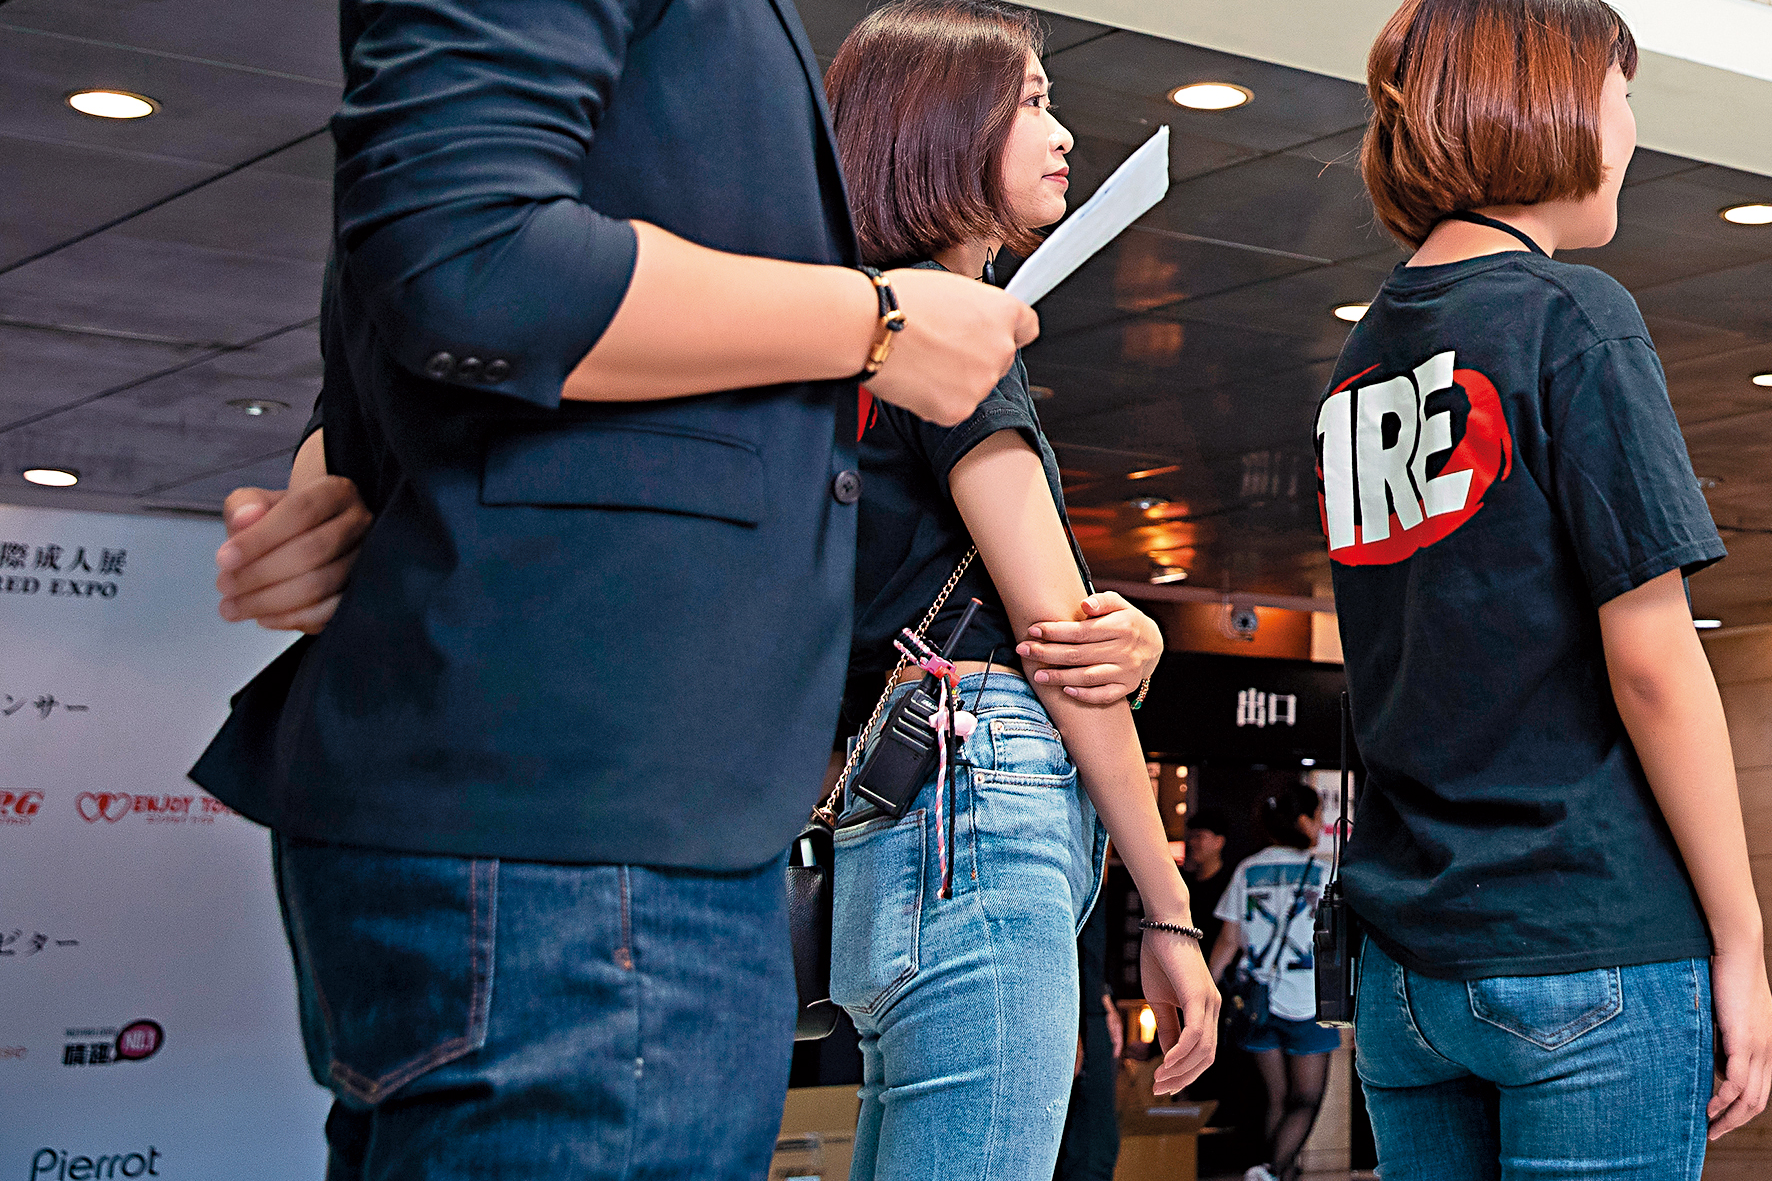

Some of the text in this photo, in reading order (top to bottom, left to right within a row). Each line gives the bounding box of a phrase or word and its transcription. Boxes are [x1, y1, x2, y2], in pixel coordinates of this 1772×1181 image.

[1317, 351, 1474, 551] TRE
[49, 578, 118, 600] EXPO
[1237, 687, 1297, 728] 出口
[32, 1146, 161, 1181] Pierrot
